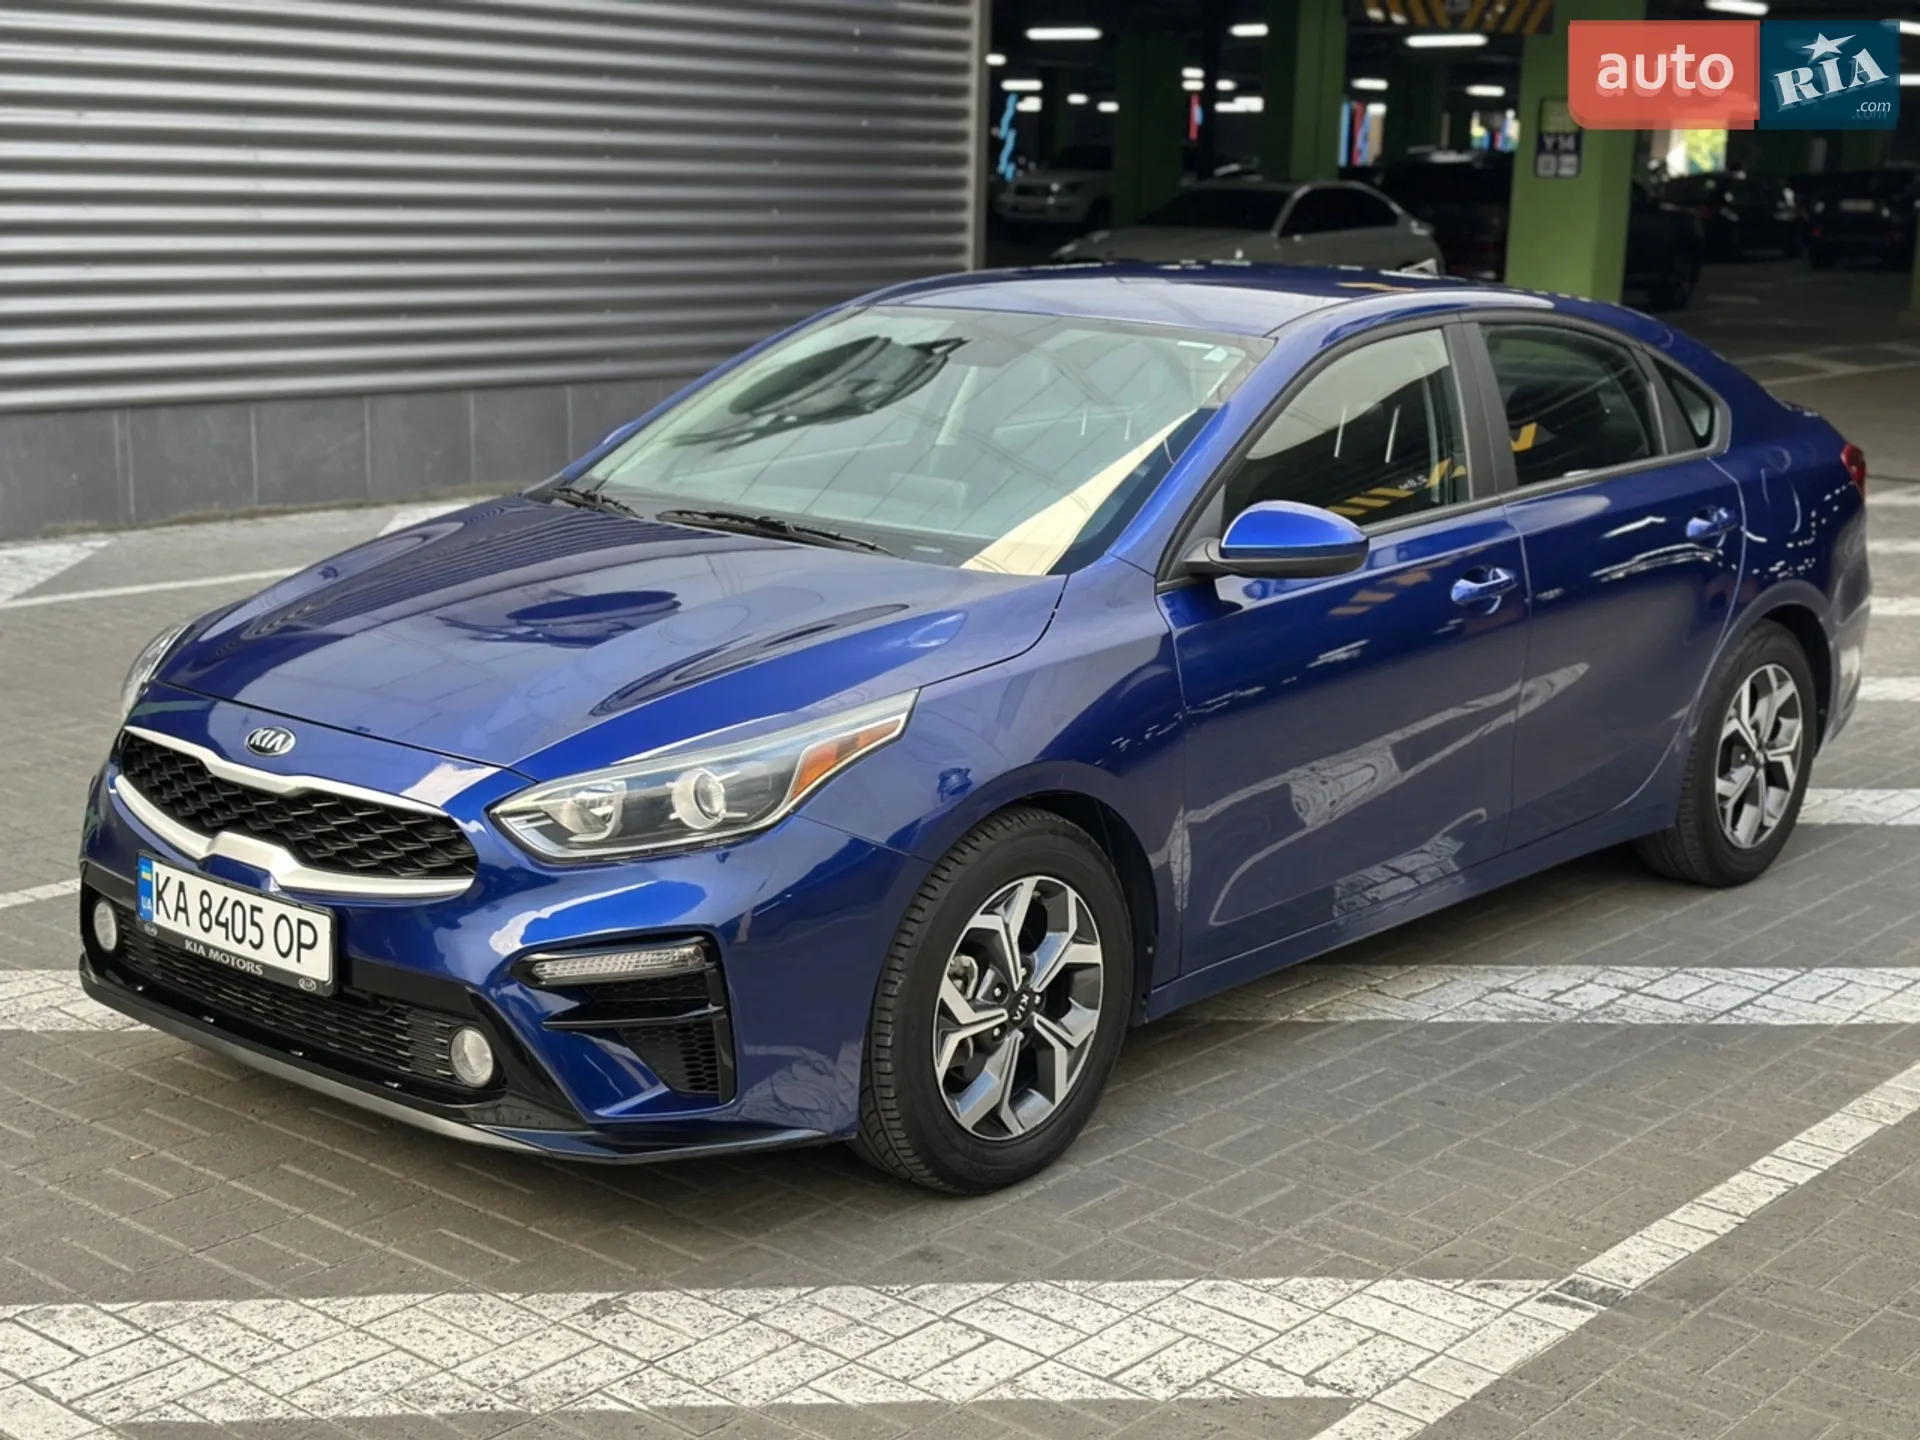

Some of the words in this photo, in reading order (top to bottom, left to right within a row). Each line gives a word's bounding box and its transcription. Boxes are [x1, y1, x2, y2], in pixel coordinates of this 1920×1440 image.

[250, 728, 290, 751] KIA
[140, 895, 153, 911] UA
[155, 871, 190, 927] KA
[199, 889, 264, 950] 8405
[273, 913, 319, 964] OP
[184, 939, 206, 957] KIA
[208, 948, 263, 976] MOTORS
